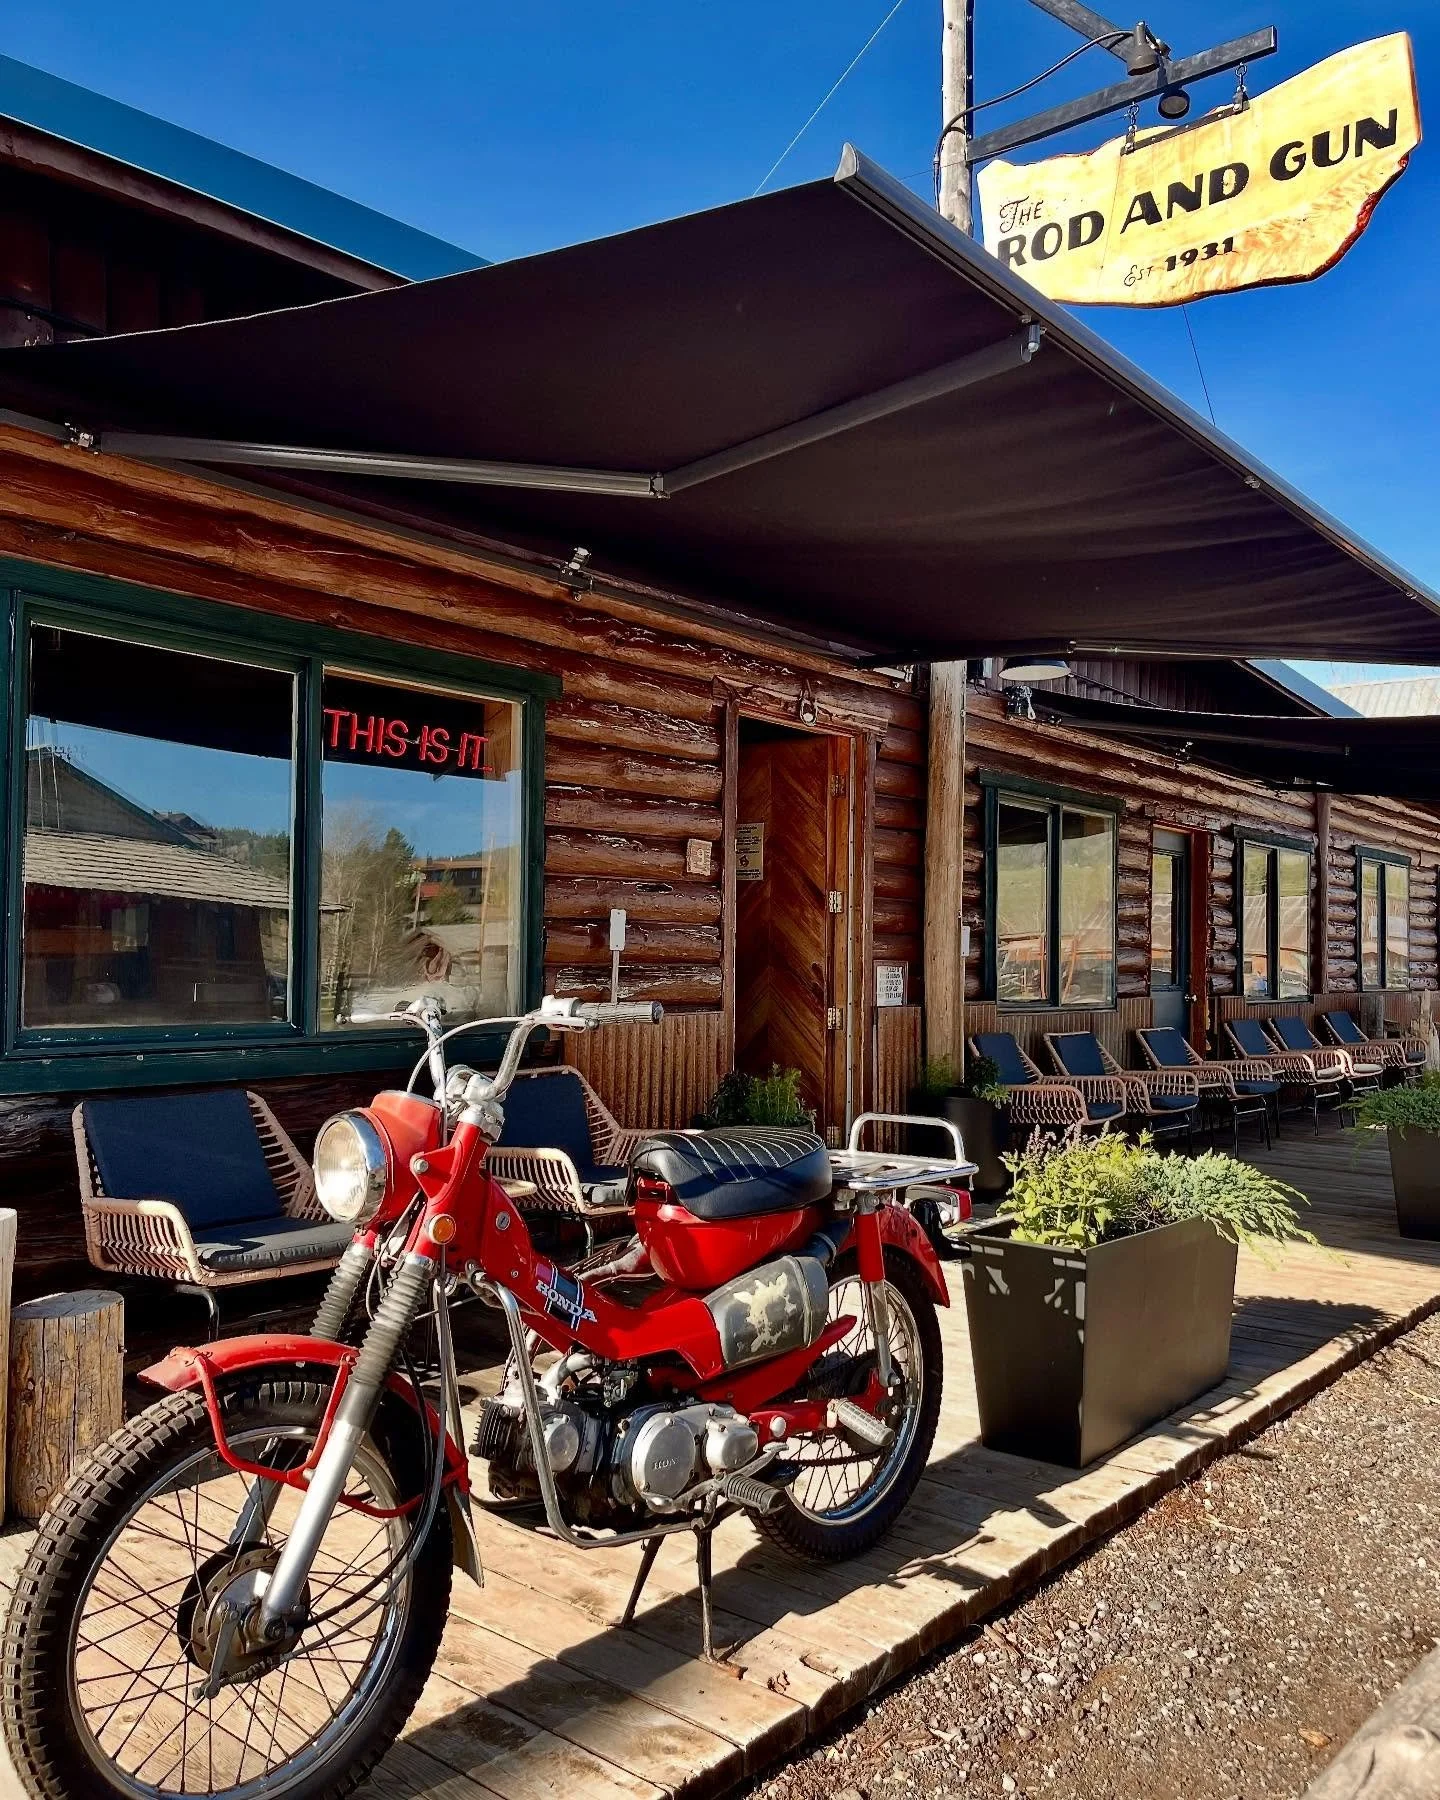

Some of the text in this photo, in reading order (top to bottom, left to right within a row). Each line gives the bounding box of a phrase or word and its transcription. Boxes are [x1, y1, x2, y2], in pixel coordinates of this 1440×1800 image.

[997, 108, 1398, 269] ROD AND GUN
[999, 195, 1044, 234] THE
[1165, 236, 1234, 272] 1931
[323, 708, 409, 757] THIS
[418, 725, 450, 763] IS
[535, 1279, 598, 1323] HONDA
